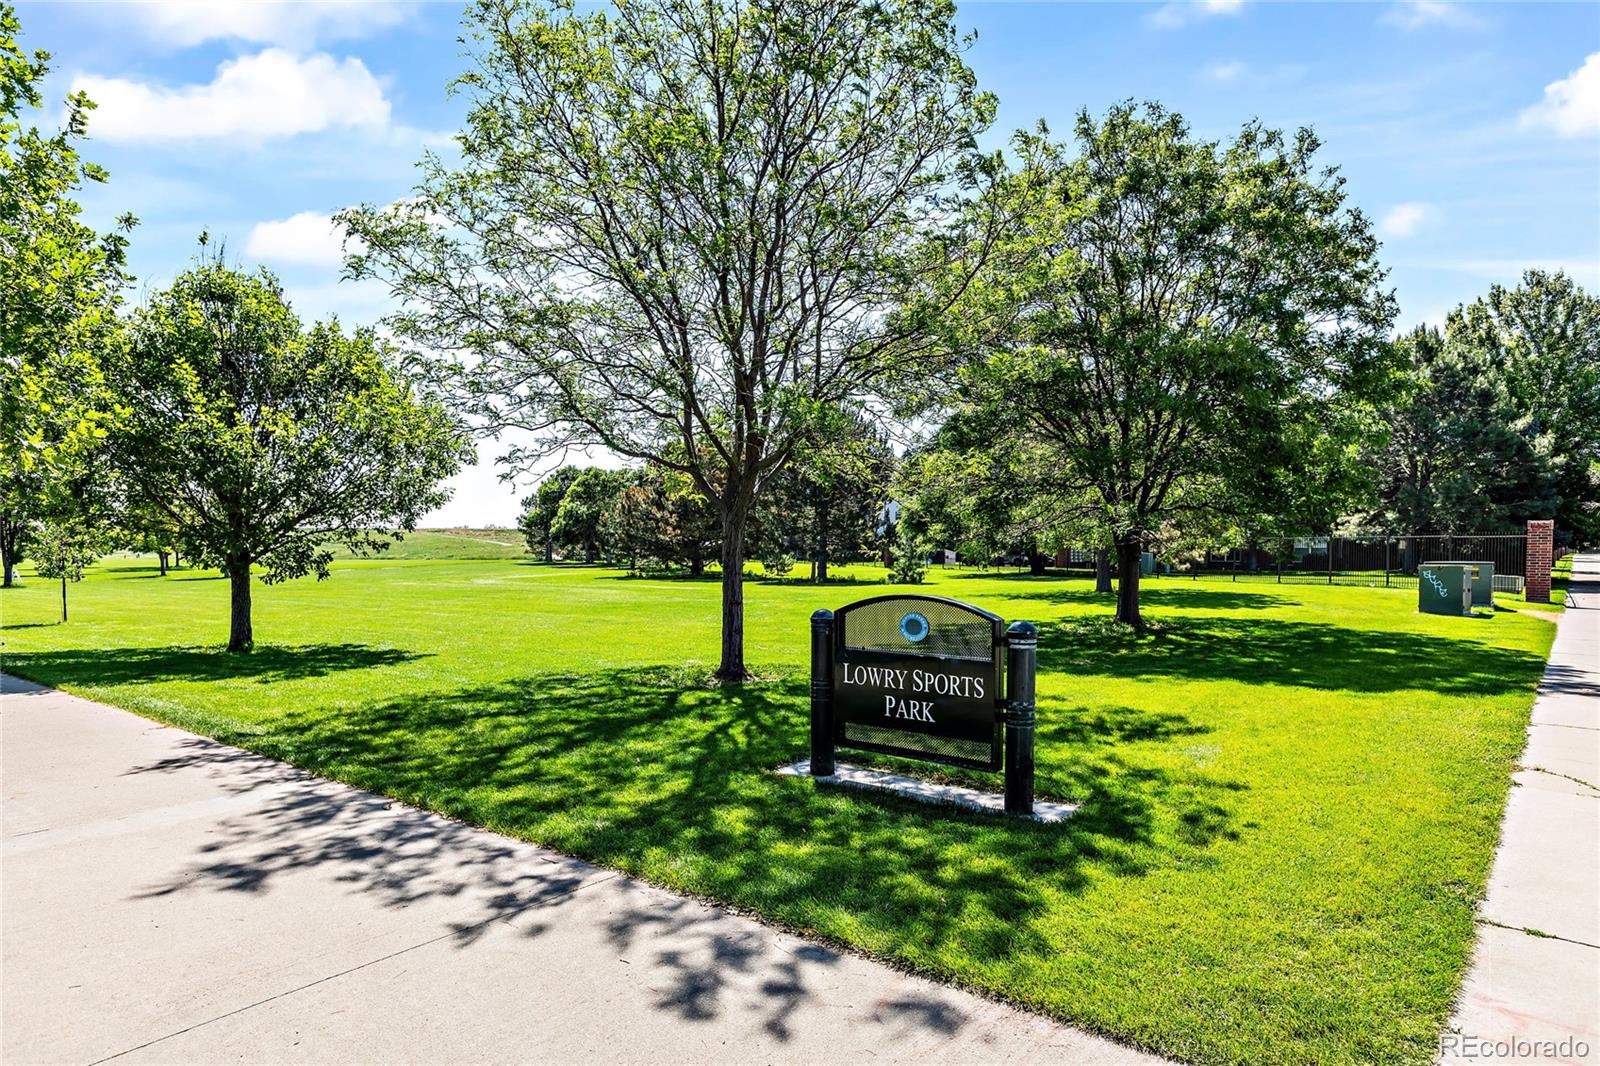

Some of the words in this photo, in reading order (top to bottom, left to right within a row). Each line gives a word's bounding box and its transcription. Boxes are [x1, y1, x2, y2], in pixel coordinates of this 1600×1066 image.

[843, 662, 908, 690] LOWRY
[912, 669, 985, 699] SPORTS
[884, 695, 936, 723] PARK
